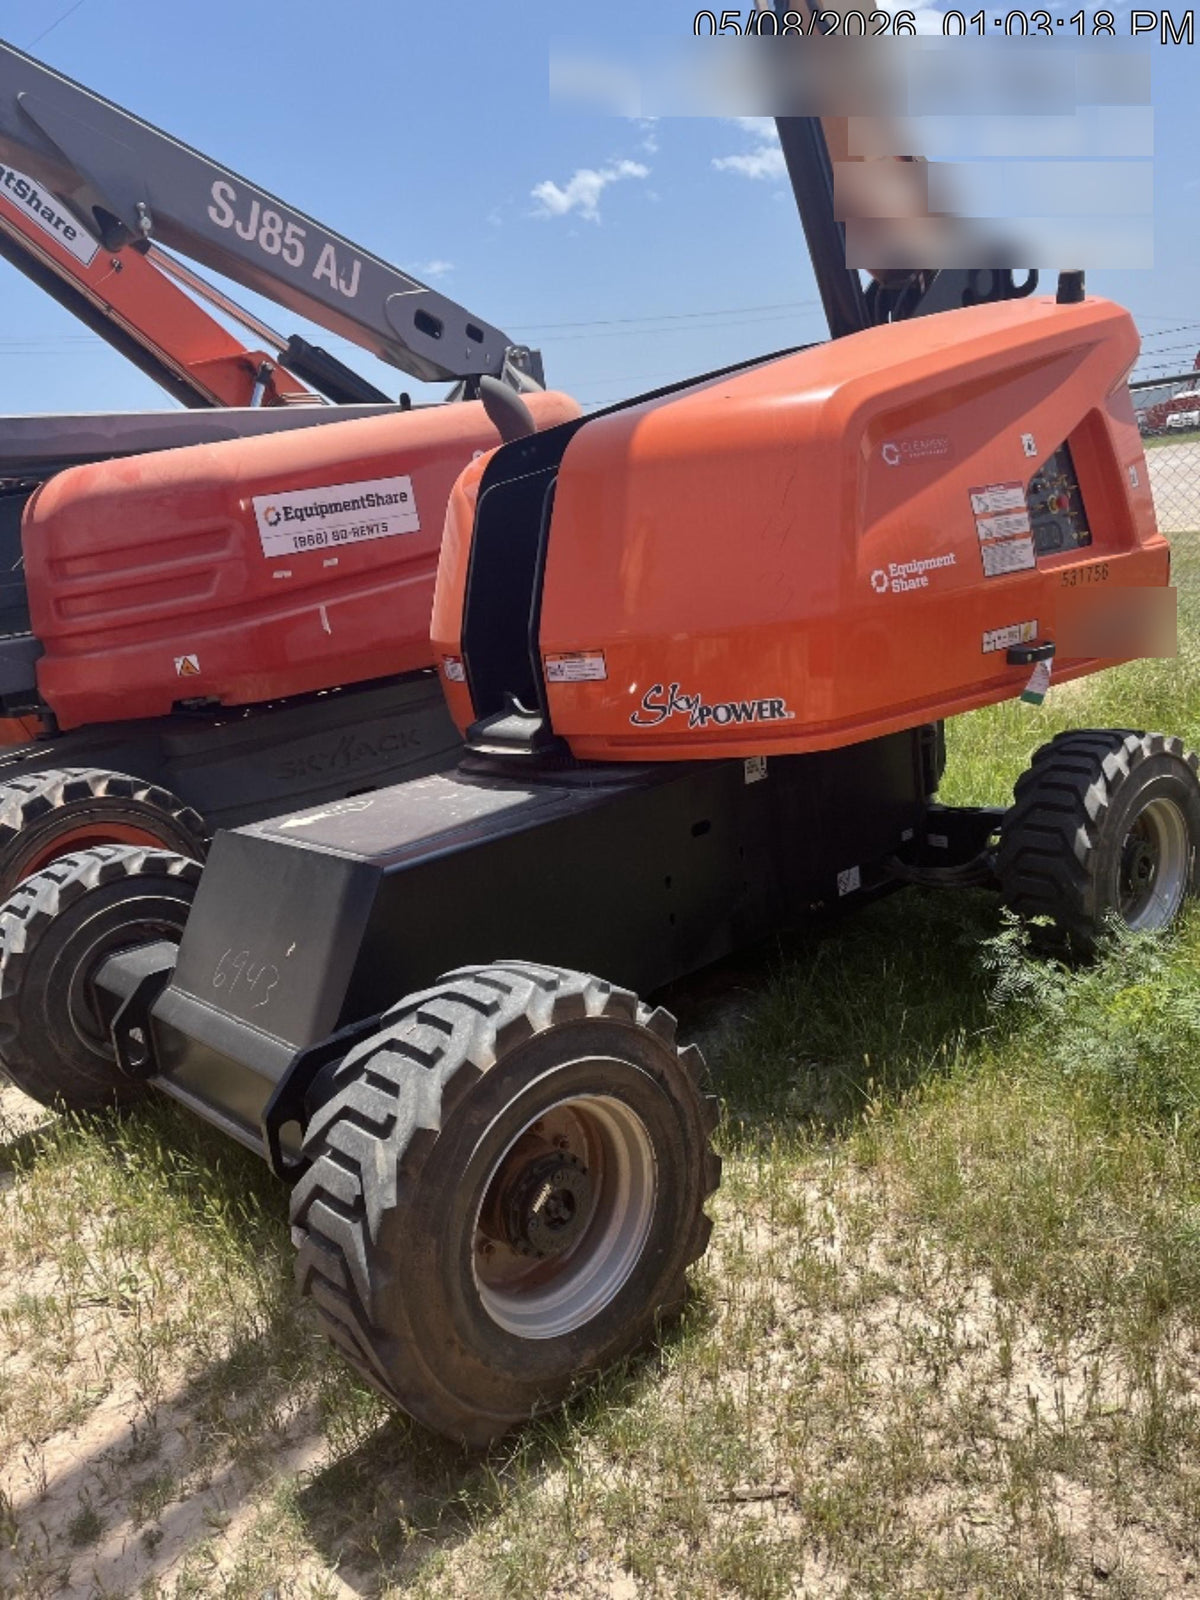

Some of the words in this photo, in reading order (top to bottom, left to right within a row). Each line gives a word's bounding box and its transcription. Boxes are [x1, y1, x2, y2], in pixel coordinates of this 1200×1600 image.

[207, 180, 306, 268] SJ85
[312, 243, 362, 298] AJ
[282, 491, 408, 522] EquipmentShare
[888, 552, 956, 578] Equipment
[1061, 563, 1109, 587] 531756
[891, 575, 929, 593] Share
[212, 948, 280, 1009] 6943
